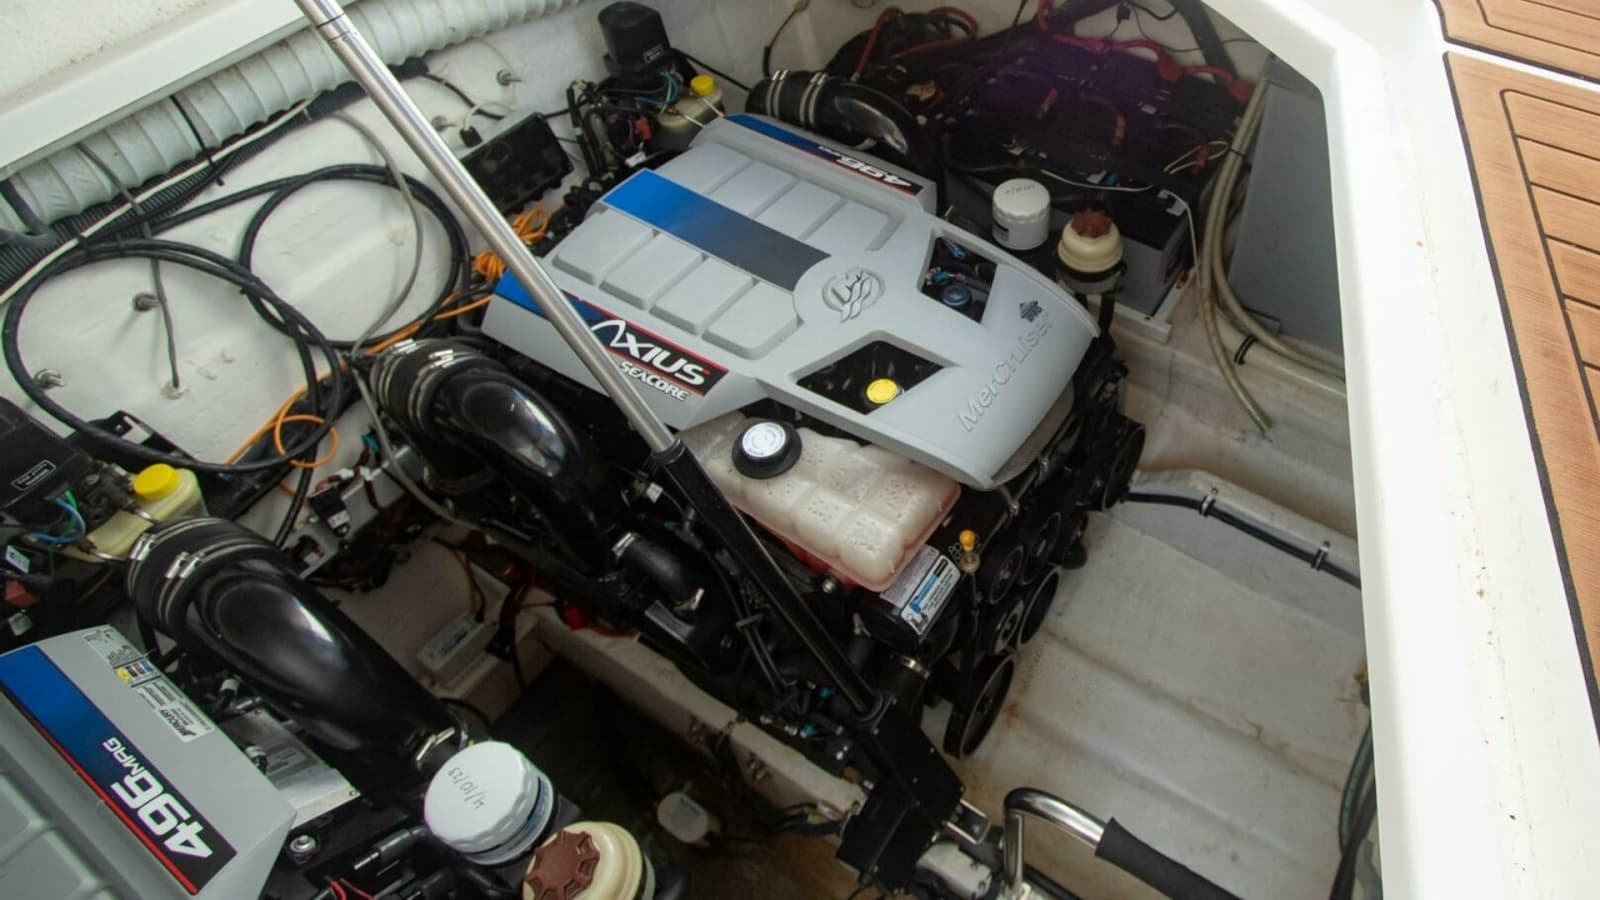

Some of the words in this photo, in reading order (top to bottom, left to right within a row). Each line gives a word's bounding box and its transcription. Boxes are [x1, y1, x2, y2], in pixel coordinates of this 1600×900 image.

[591, 319, 706, 386] AXIUS
[619, 360, 691, 401] SEACORE
[102, 737, 145, 776] MAG
[110, 769, 214, 858] 496
